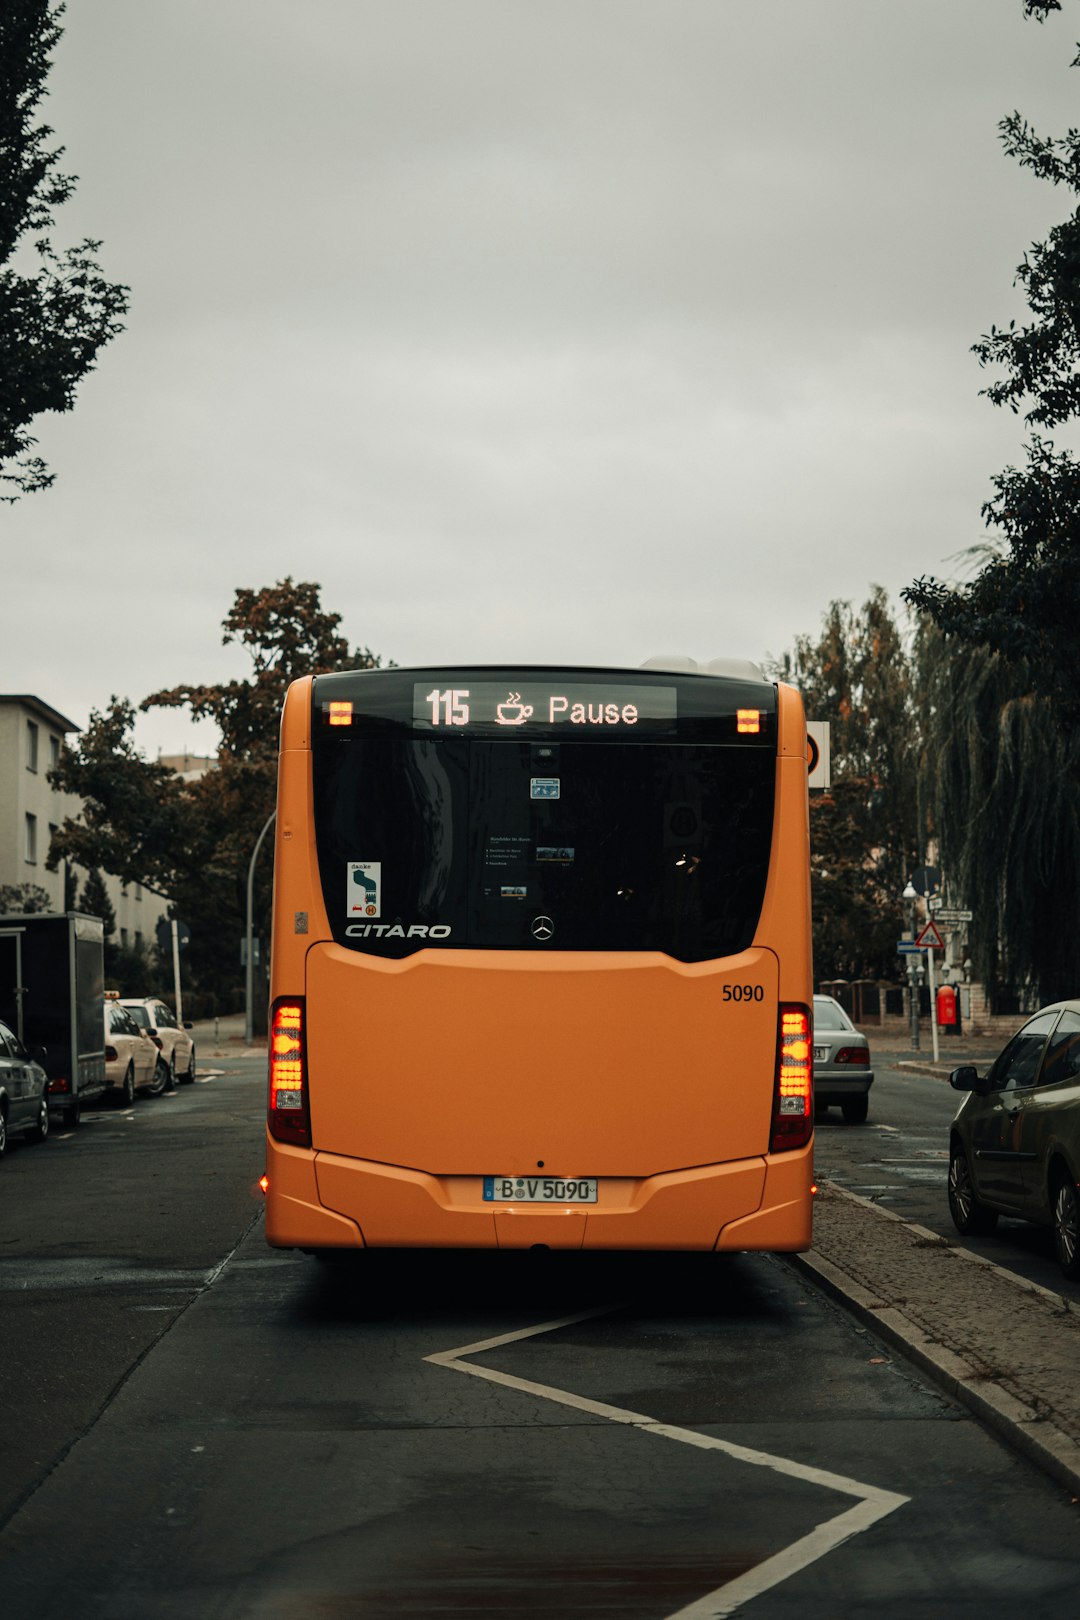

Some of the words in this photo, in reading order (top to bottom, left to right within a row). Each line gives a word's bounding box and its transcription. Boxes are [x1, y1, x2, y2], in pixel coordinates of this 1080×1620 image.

[426, 689, 469, 725] 115
[549, 696, 638, 724] Pause
[345, 924, 452, 938] CITARO
[722, 985, 764, 1001] 5090
[501, 1180, 513, 1198] B
[527, 1180, 538, 1198] V
[543, 1181, 589, 1199] 5090
